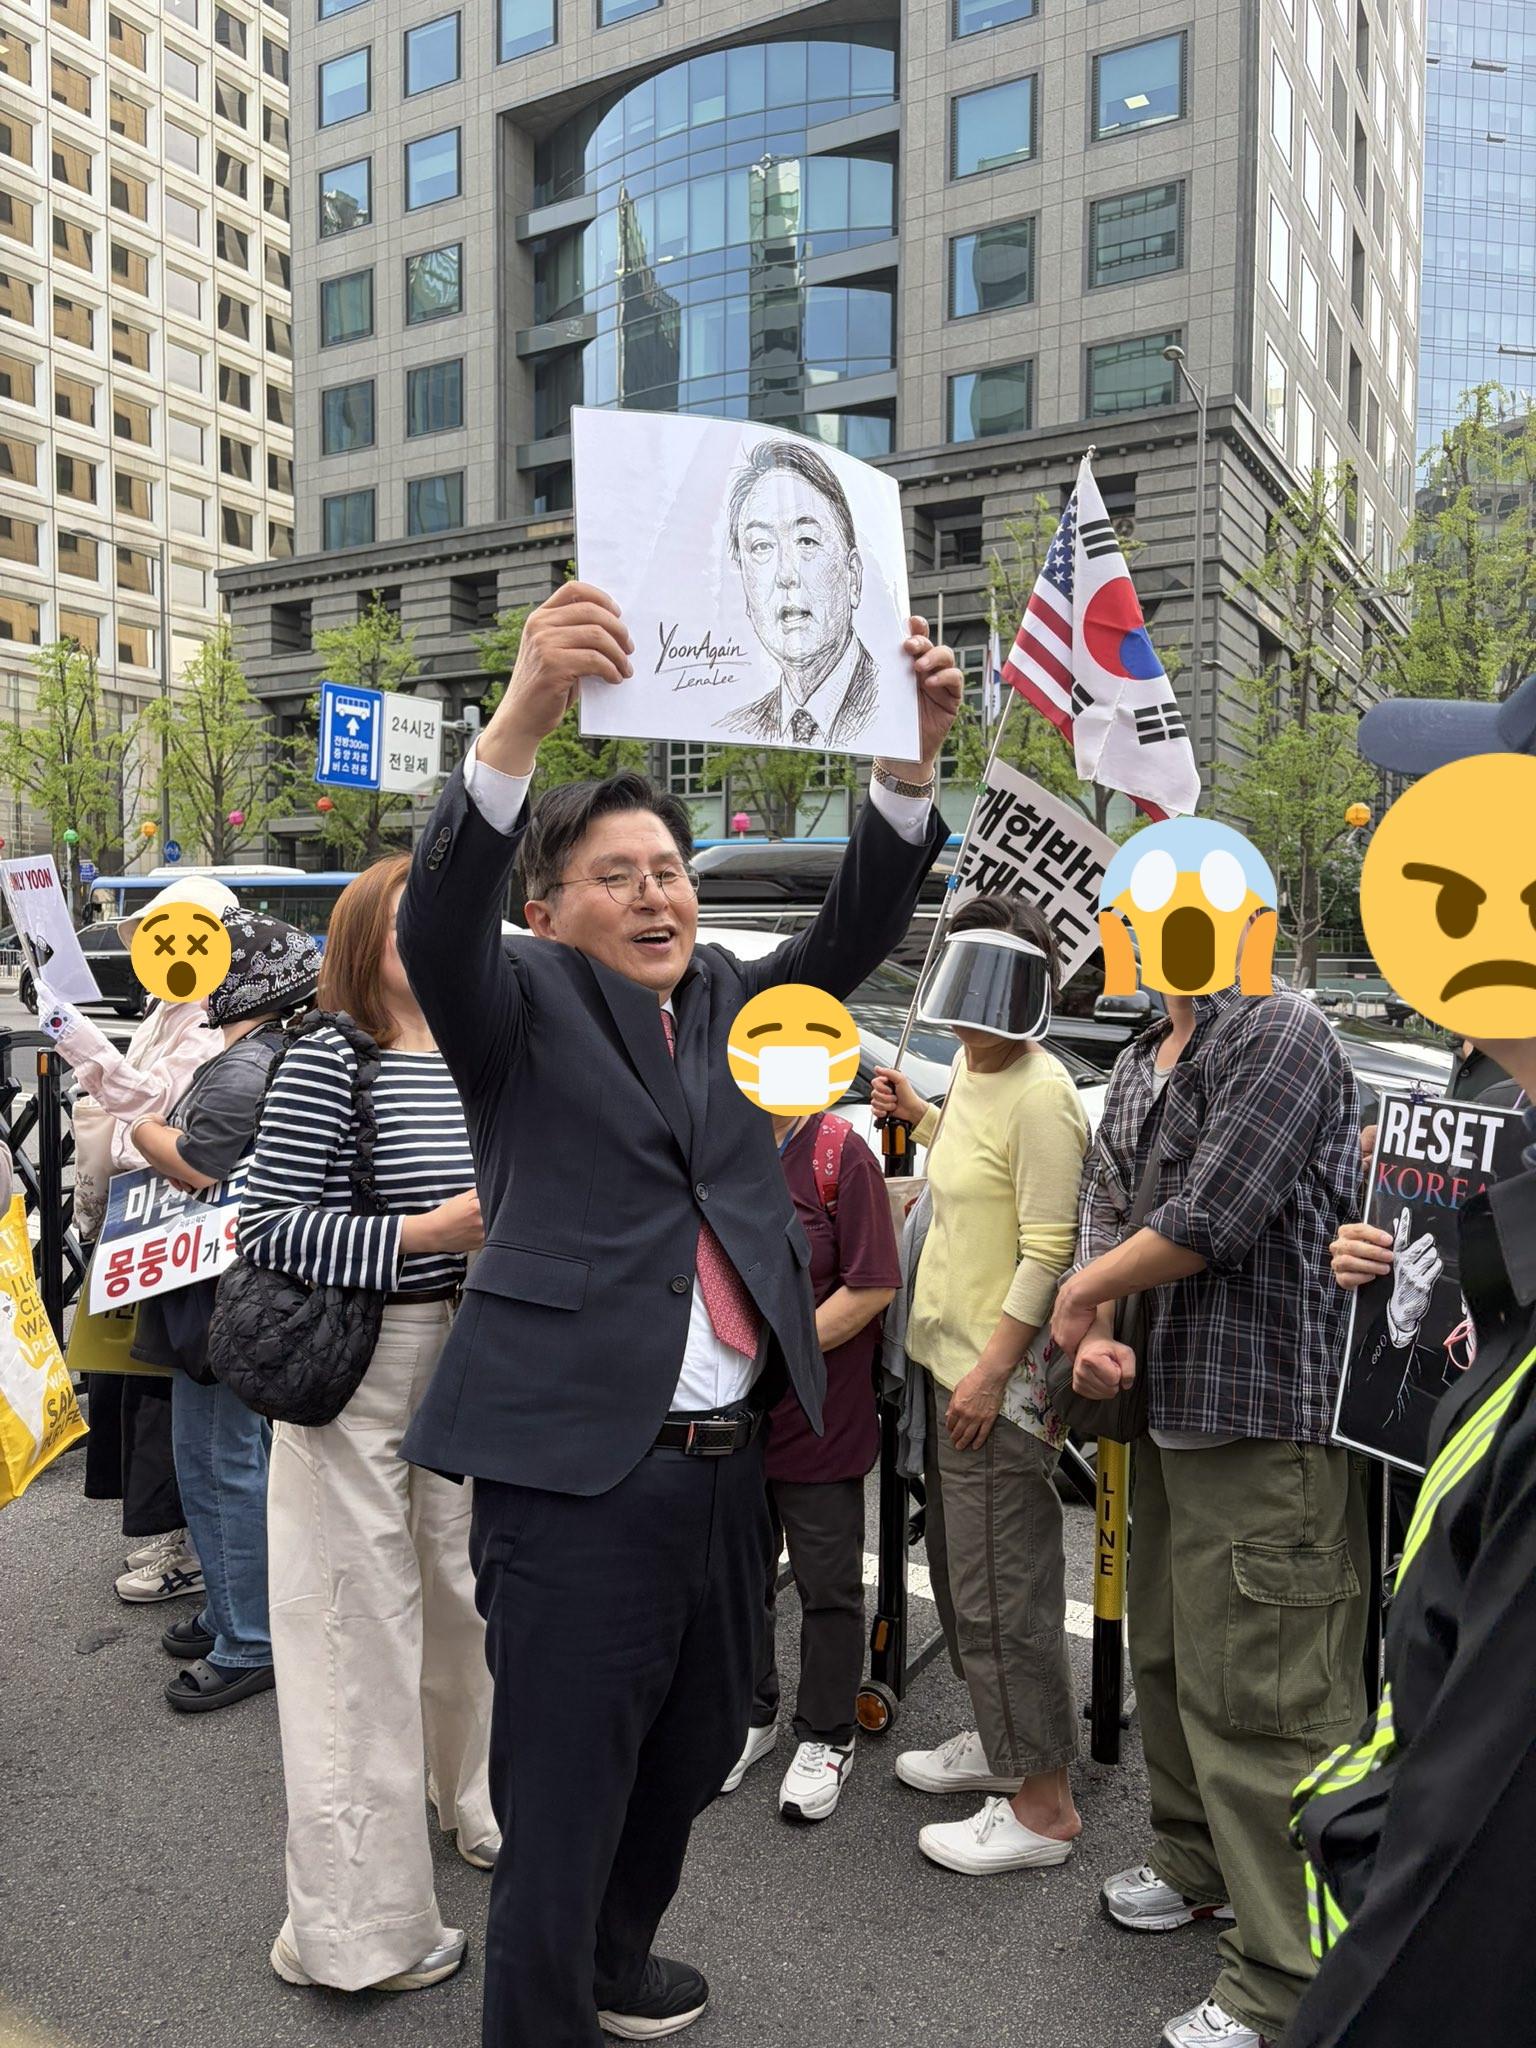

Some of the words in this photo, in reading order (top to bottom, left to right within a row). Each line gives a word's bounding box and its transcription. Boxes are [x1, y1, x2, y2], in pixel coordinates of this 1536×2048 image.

[655, 621, 748, 674] YoonAgain
[391, 716, 435, 740] 24시간
[389, 753, 429, 775] 전일제
[24, 867, 53, 890] YOON
[271, 973, 291, 992] New
[291, 967, 306, 982] Era
[1382, 1101, 1505, 1173] RESET
[1375, 1162, 1487, 1210] KORE
[104, 1224, 221, 1298] 몽둥이가
[20, 1292, 43, 1316] CL
[1100, 1471, 1116, 1577] LINE
